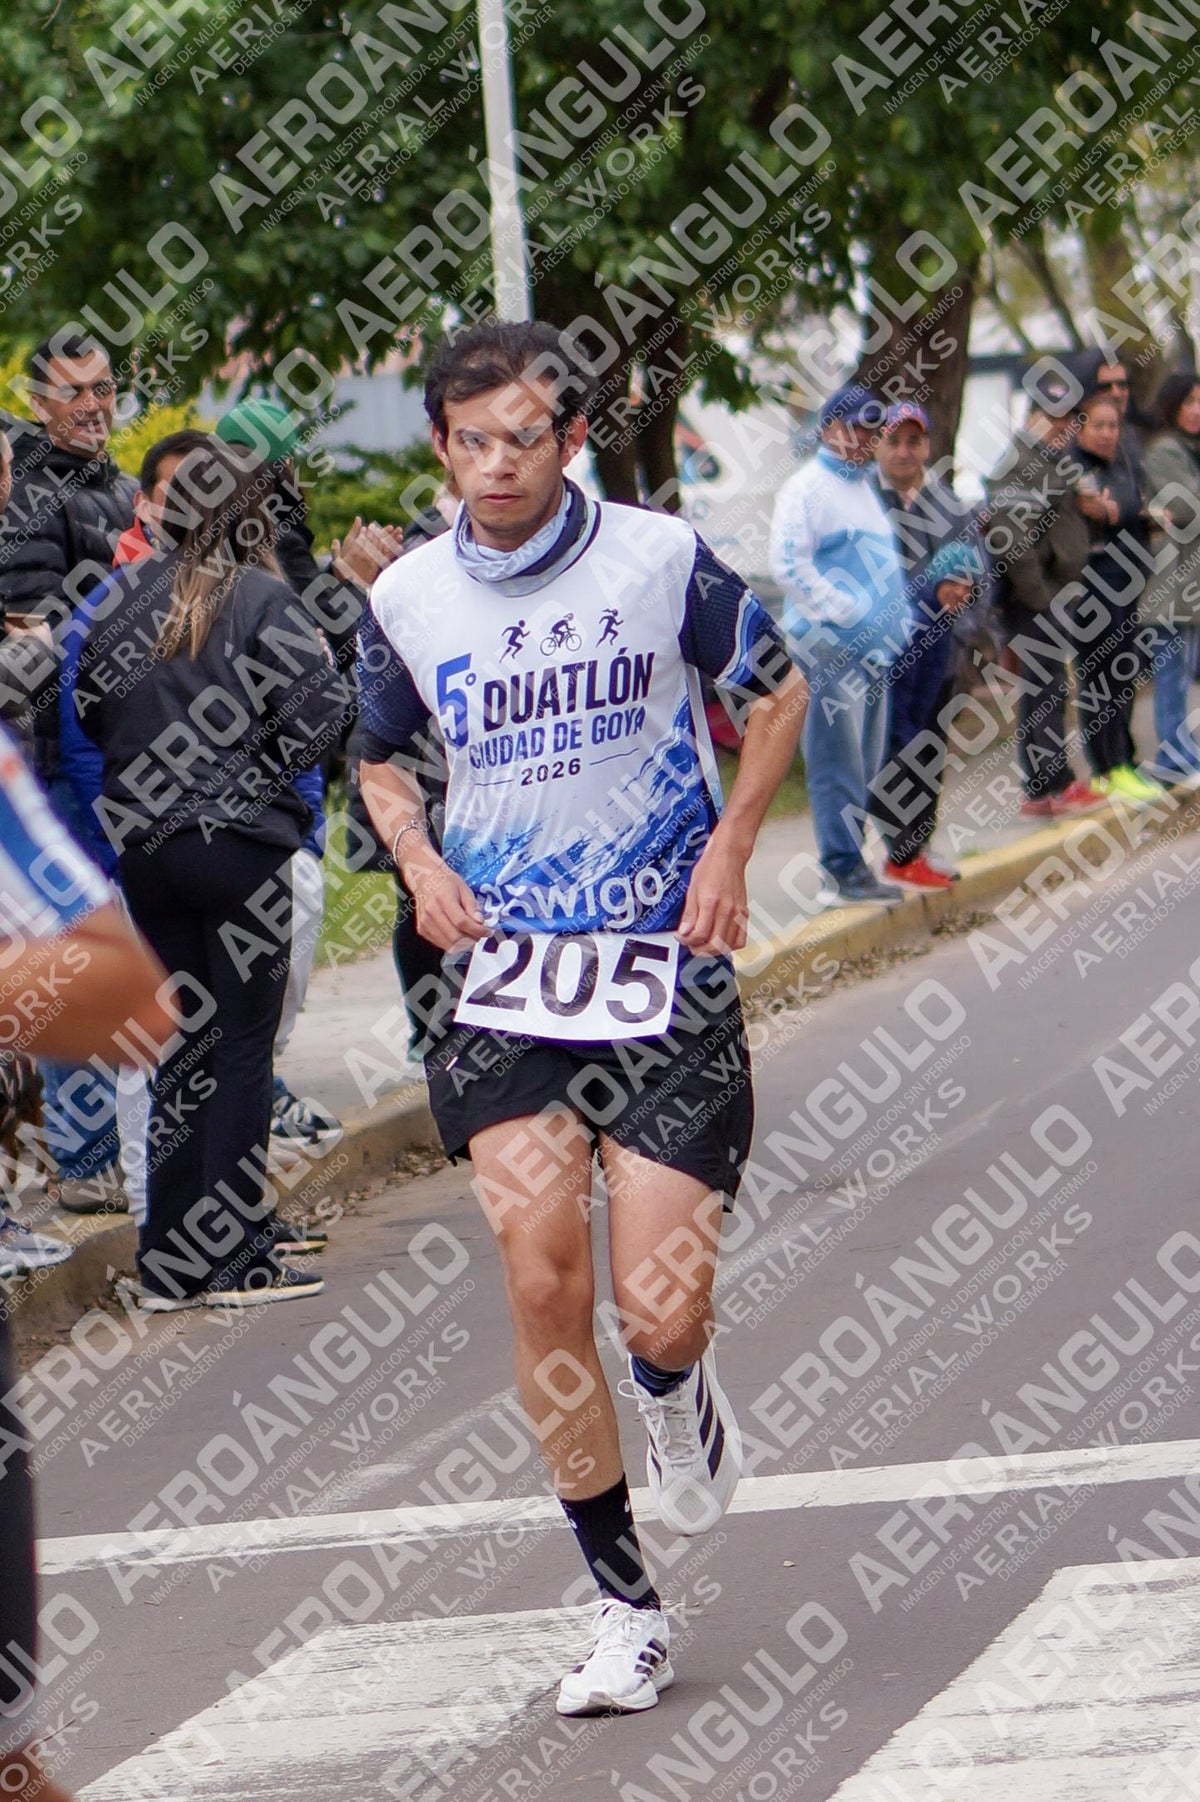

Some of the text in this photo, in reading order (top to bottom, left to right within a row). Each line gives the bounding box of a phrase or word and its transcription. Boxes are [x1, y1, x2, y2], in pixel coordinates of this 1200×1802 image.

[483, 646, 656, 733] DUATLÓN
[468, 705, 647, 770] CIUDAD DE GOYA
[520, 757, 582, 787] 2026
[464, 931, 671, 1025] 205
